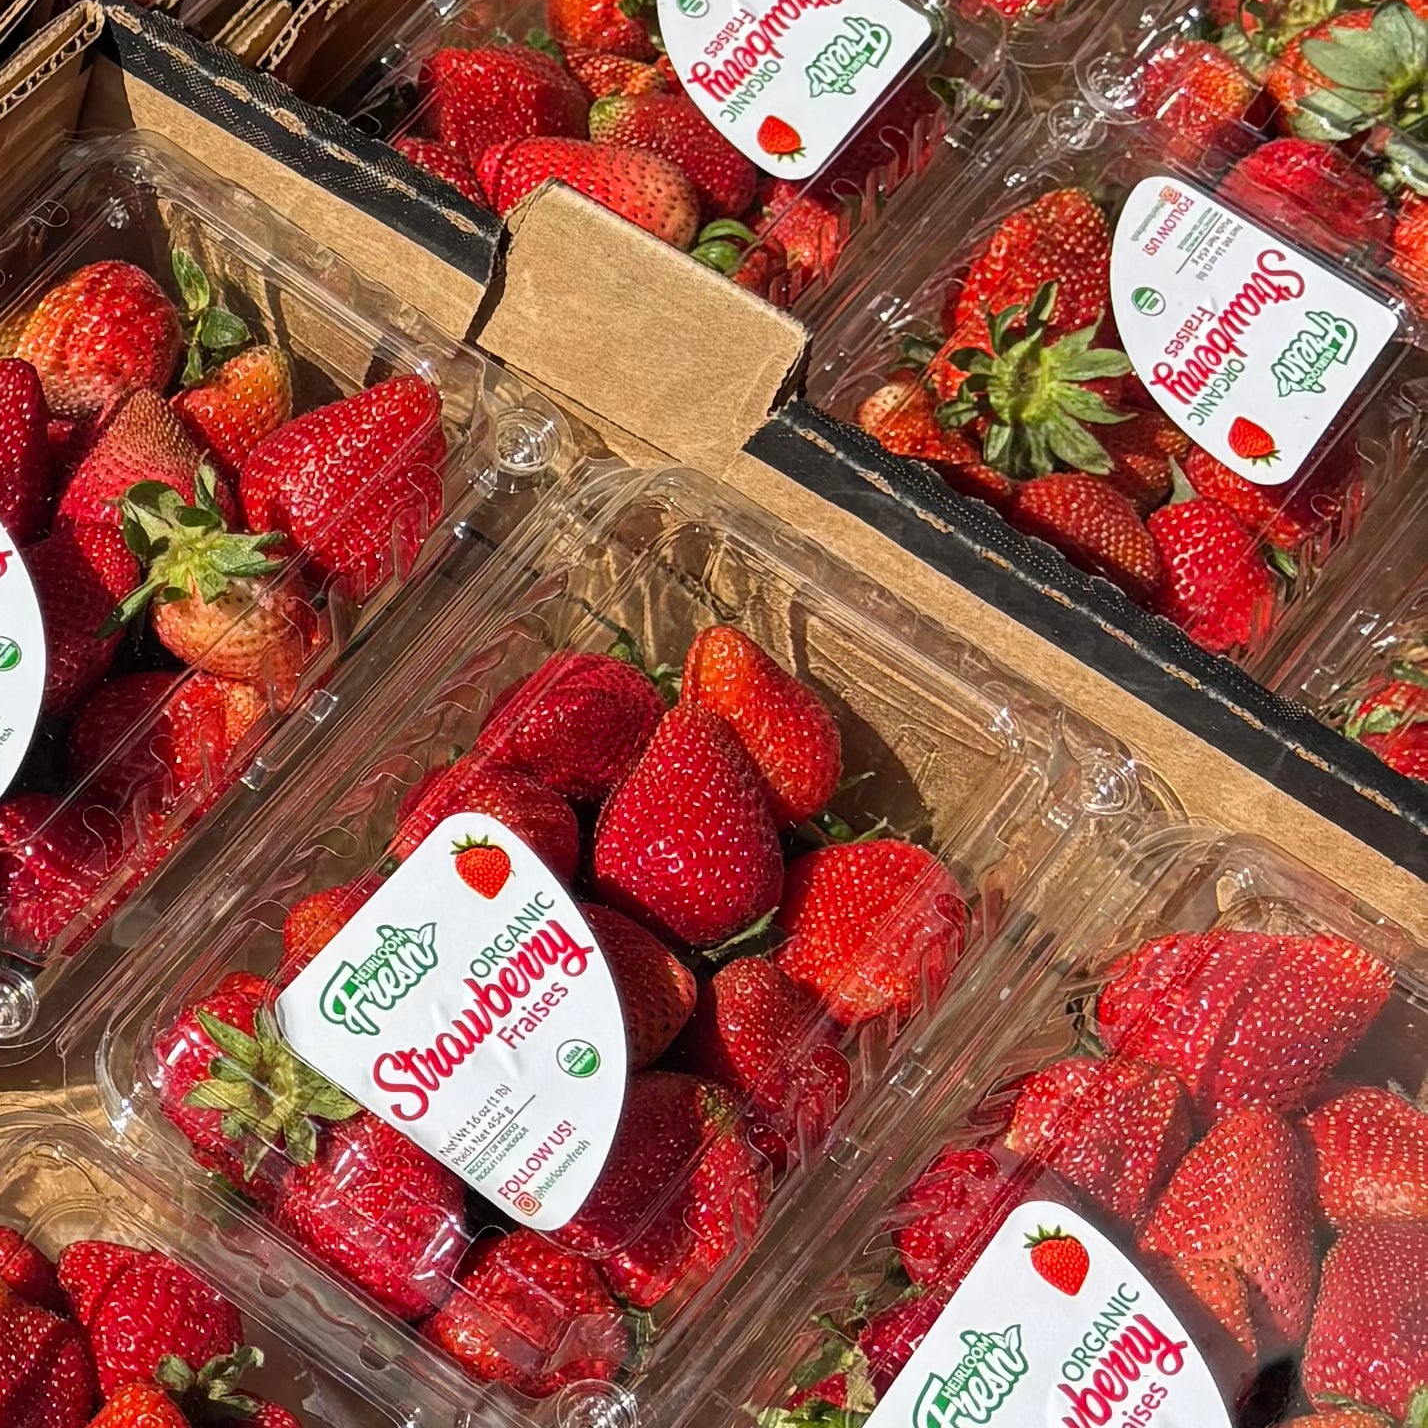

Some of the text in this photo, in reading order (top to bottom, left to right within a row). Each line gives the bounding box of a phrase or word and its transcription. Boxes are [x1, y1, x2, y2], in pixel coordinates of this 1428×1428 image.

[704, 8, 756, 58] Fraises
[719, 60, 781, 123] ORGANIC
[1150, 249, 1306, 404] Strawberry
[1165, 304, 1216, 357] Fraises
[1187, 358, 1246, 426] ORGANIC
[470, 891, 556, 977] ORGANIC
[320, 923, 439, 1037] Fresh
[496, 982, 568, 1051] Fraises
[372, 920, 593, 1122] Strawberry
[1062, 1283, 1140, 1381] ORGANIC
